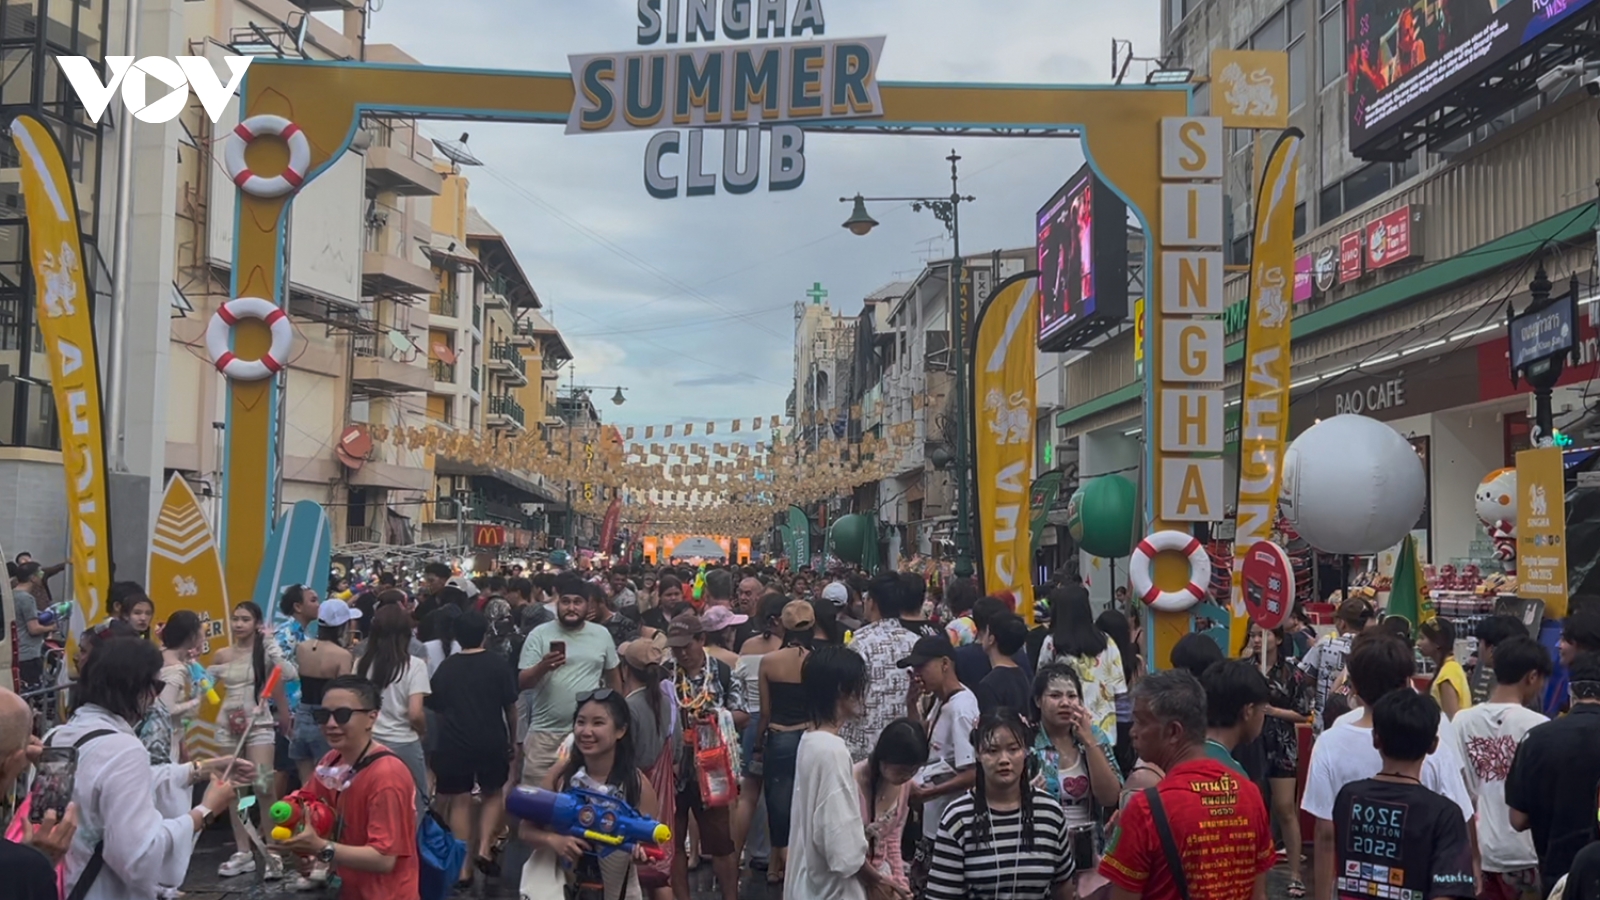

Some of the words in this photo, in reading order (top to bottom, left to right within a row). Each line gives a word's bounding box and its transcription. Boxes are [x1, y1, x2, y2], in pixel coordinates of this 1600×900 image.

[637, 0, 825, 45] SINGHA
[579, 43, 873, 130] SUMMER
[644, 124, 806, 199] CLUB
[1175, 120, 1210, 515] SINGHA
[1336, 389, 1363, 415] BAO
[1351, 803, 1402, 827] ROSE
[1362, 824, 1400, 838] MOTION
[1353, 836, 1396, 858] 2022
